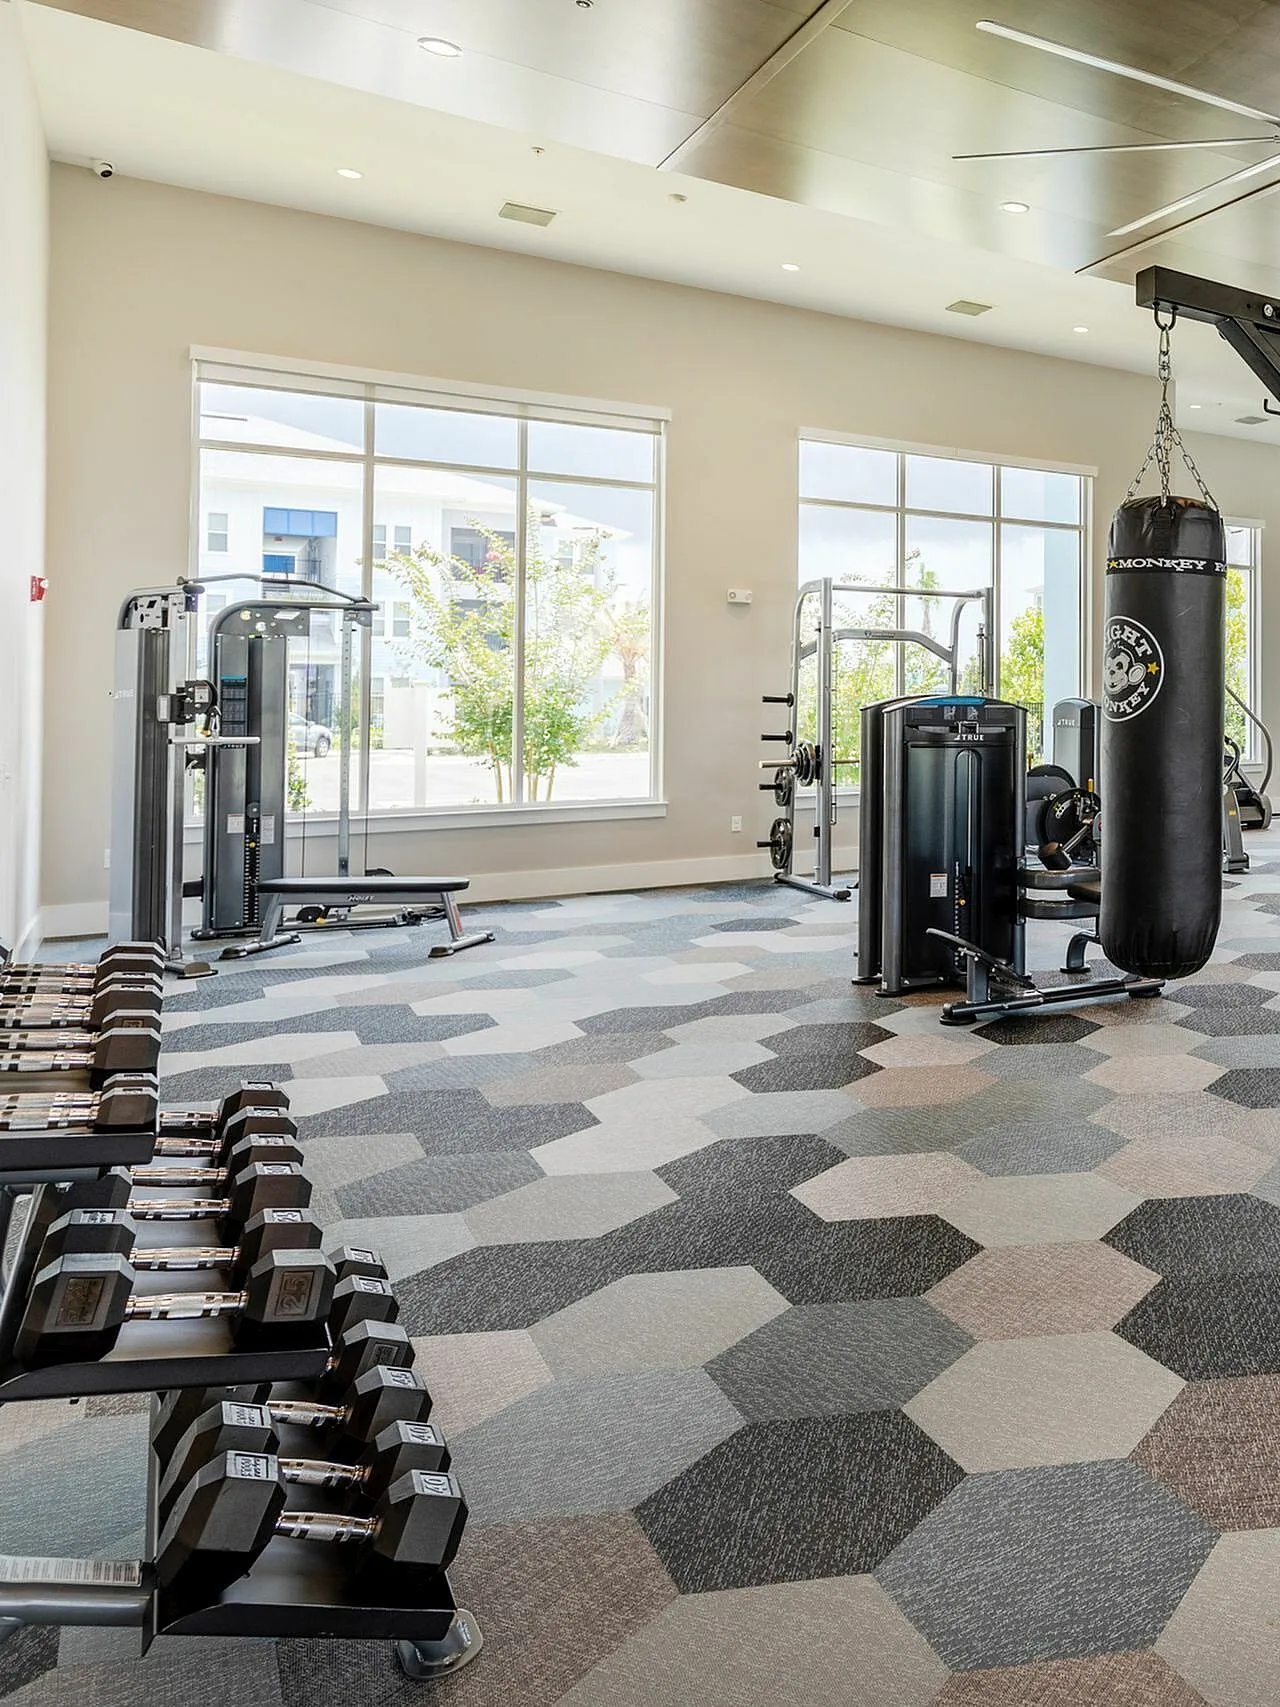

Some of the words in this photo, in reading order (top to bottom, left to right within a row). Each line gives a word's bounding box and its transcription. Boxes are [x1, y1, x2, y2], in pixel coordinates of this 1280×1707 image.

[1119, 558, 1206, 572] MONKEY
[1103, 681, 1150, 713] ONKEY
[409, 1427, 432, 1442] 40
[423, 1478, 447, 1494] 40
